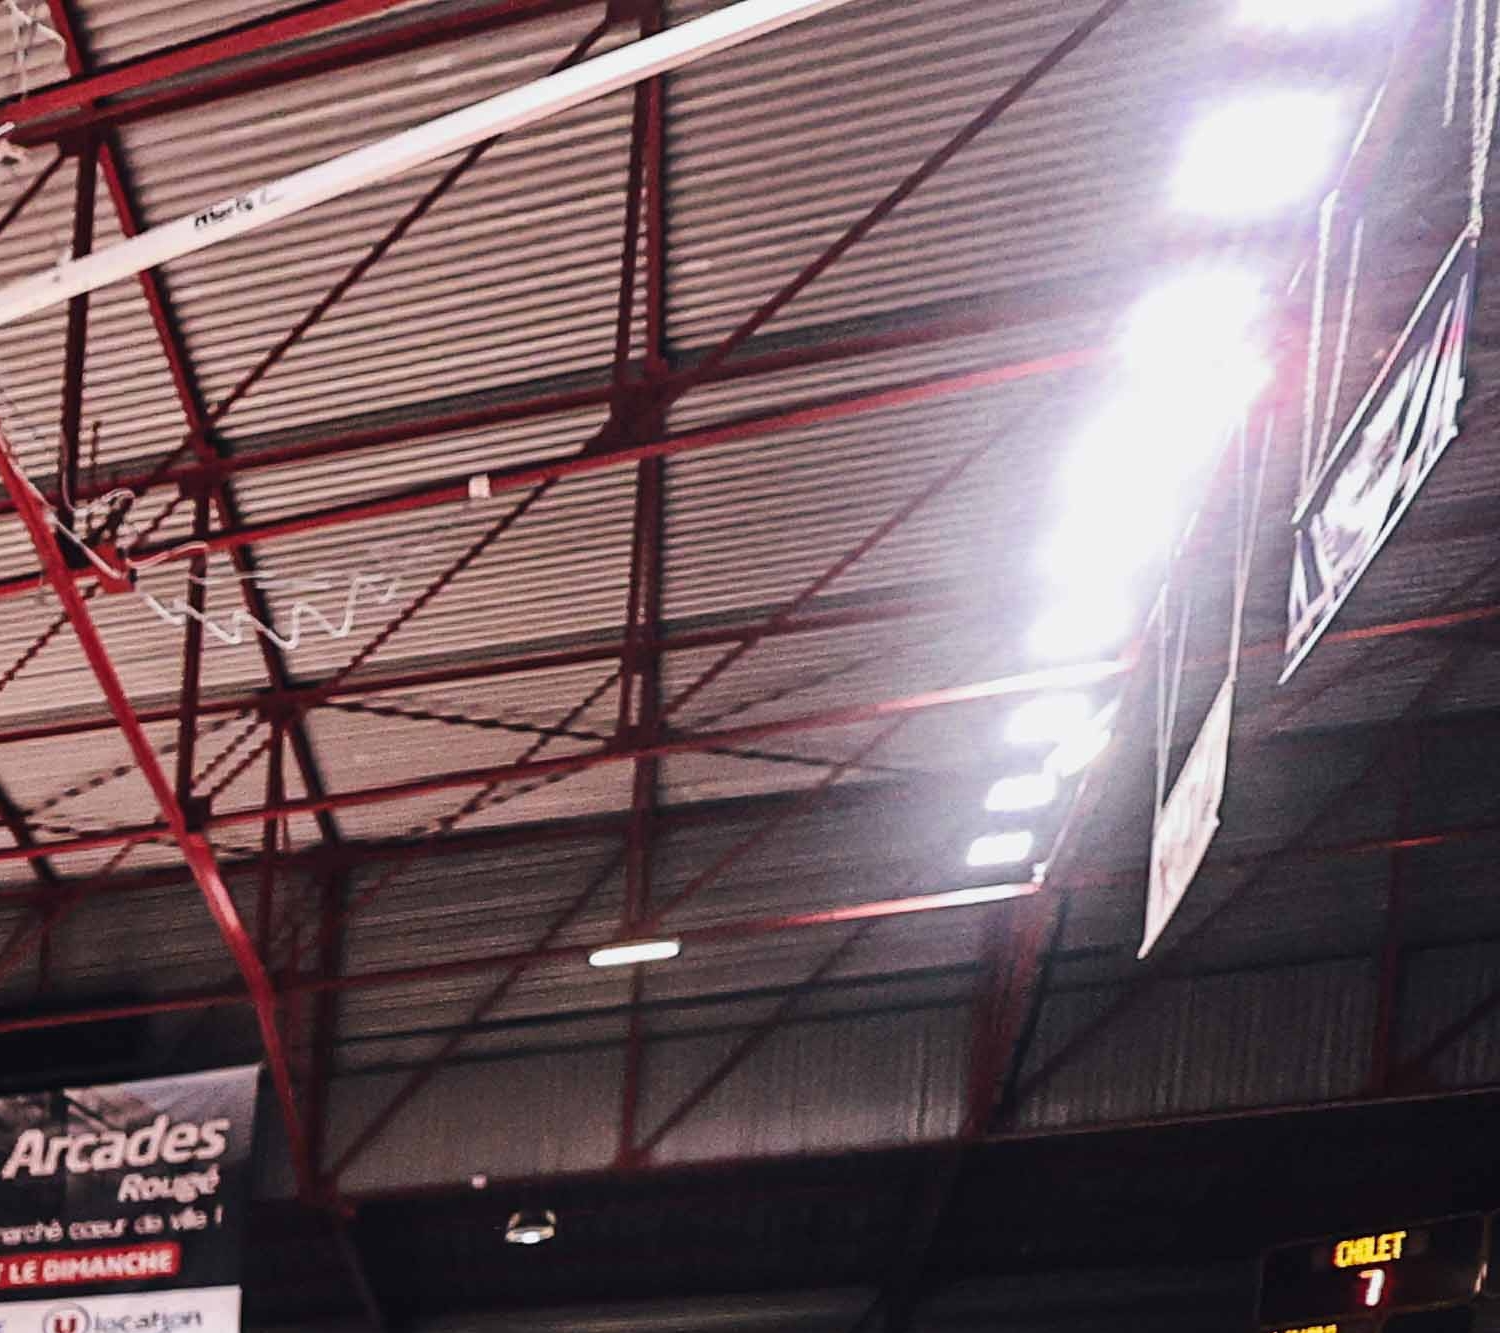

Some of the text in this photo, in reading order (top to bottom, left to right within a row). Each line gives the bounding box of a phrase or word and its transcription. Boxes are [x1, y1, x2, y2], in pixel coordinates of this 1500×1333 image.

[2, 1114, 231, 1179] Arcades
[135, 1214, 162, 1234] de
[9, 1259, 38, 1285] LE
[43, 1250, 174, 1282] DIMANCHE
[1334, 1230, 1407, 1268] CHOLET
[1357, 1268, 1386, 1306] 7
